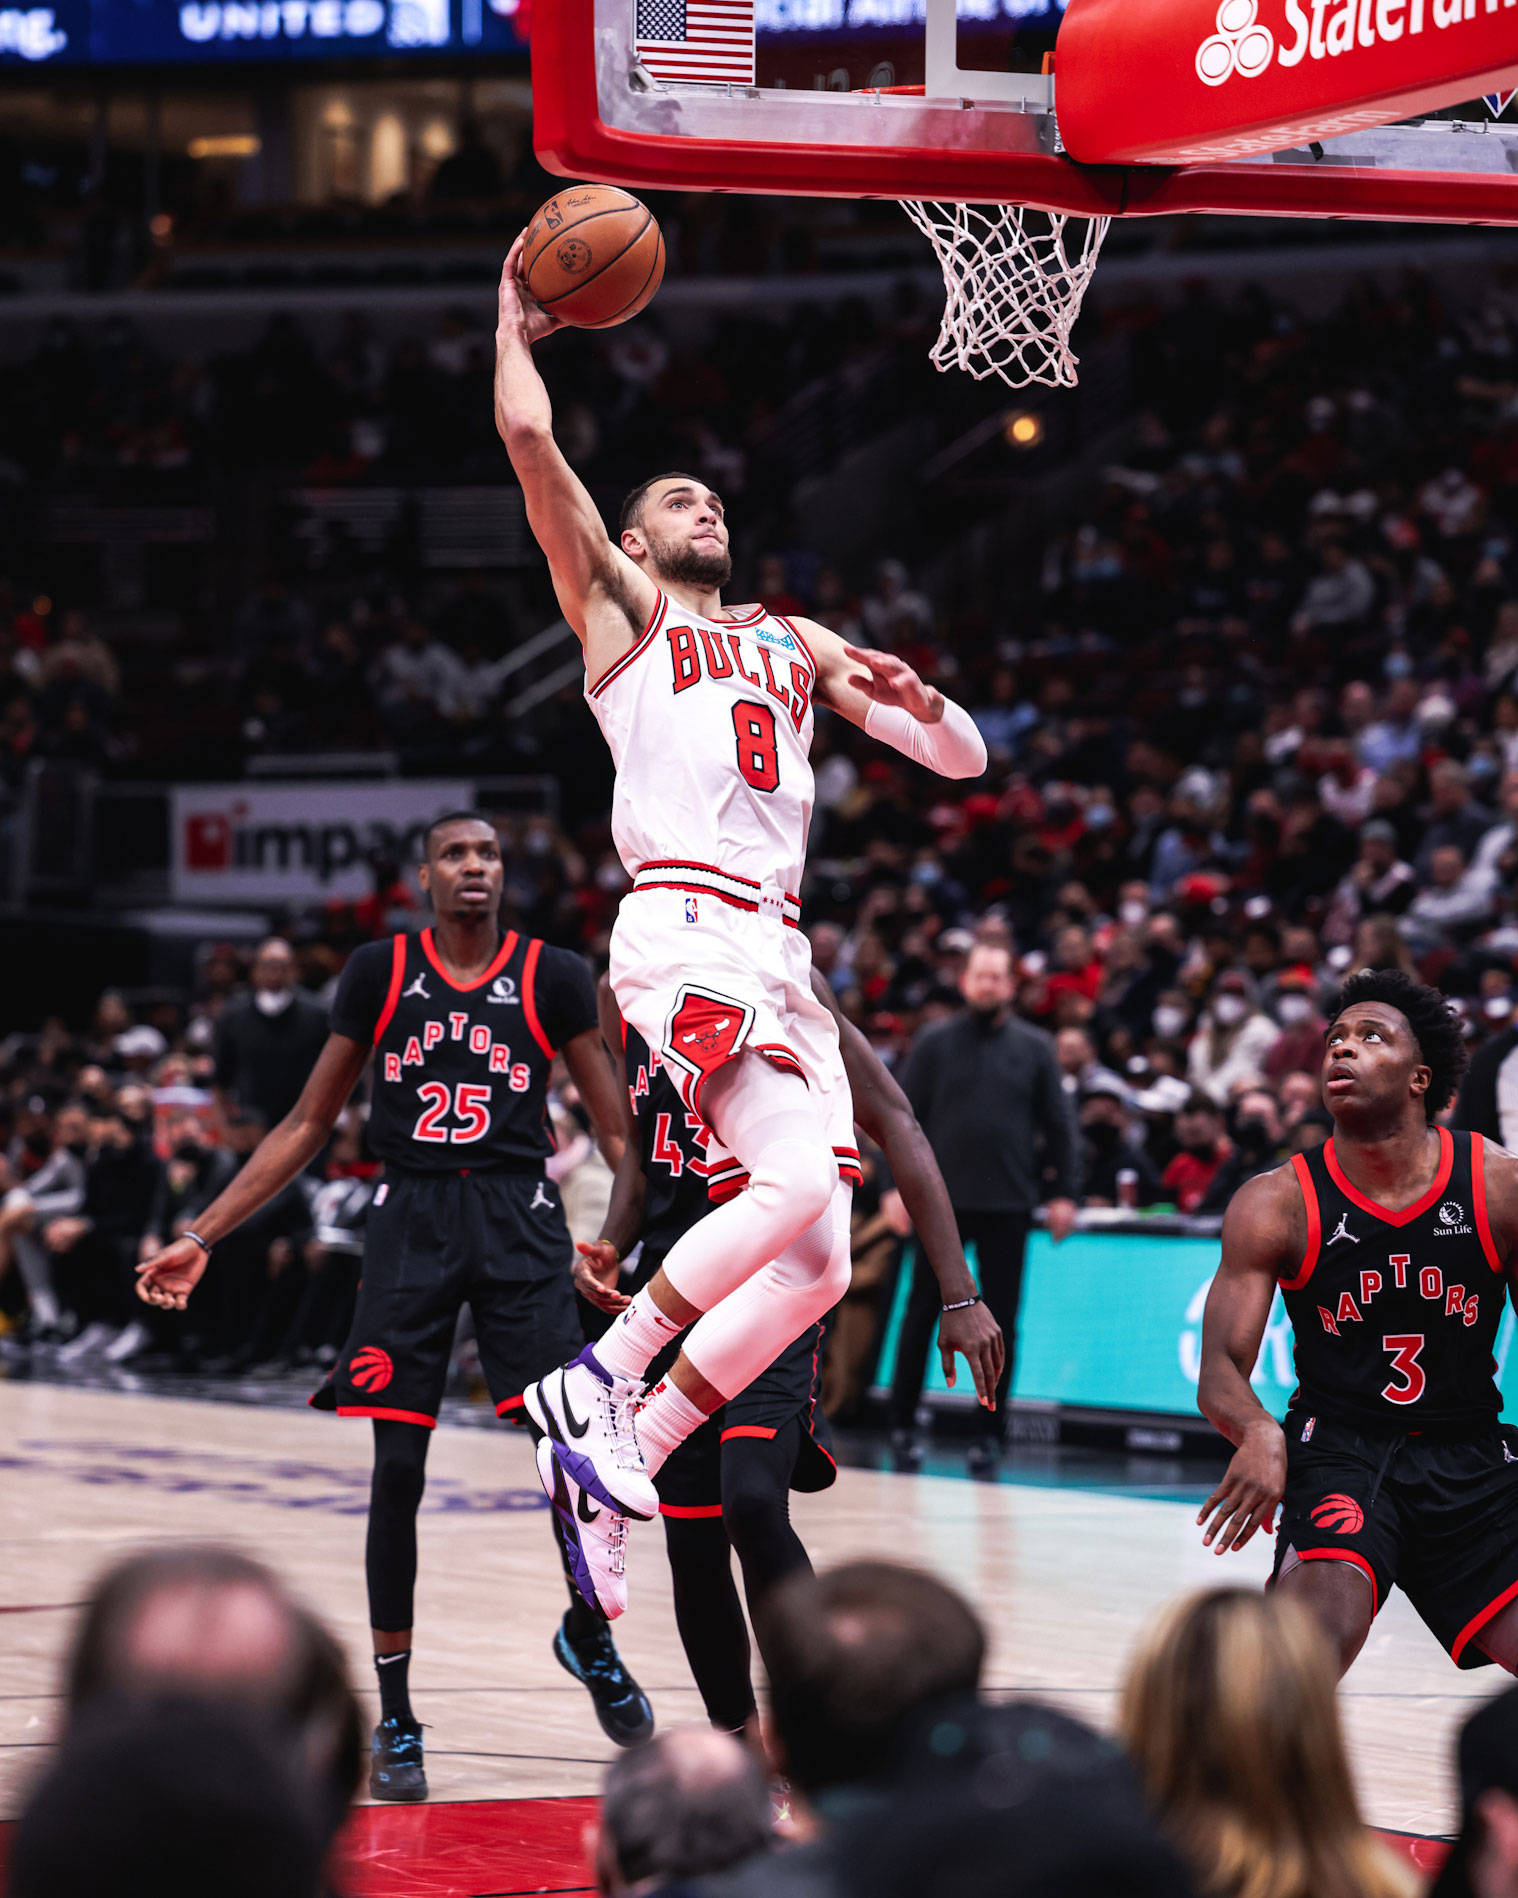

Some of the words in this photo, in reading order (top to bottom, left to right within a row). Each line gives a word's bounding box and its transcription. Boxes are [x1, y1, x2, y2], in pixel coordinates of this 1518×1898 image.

[667, 625, 811, 735] BULLS
[731, 699, 780, 793] 8
[233, 798, 434, 888] impac
[385, 1011, 530, 1092] RAPTORS
[412, 1081, 492, 1144] 25
[1433, 1227, 1453, 1236] Sun
[1454, 1224, 1472, 1234] Life
[1317, 1253, 1479, 1336] RAPTORS
[1381, 1333, 1426, 1405] 3
